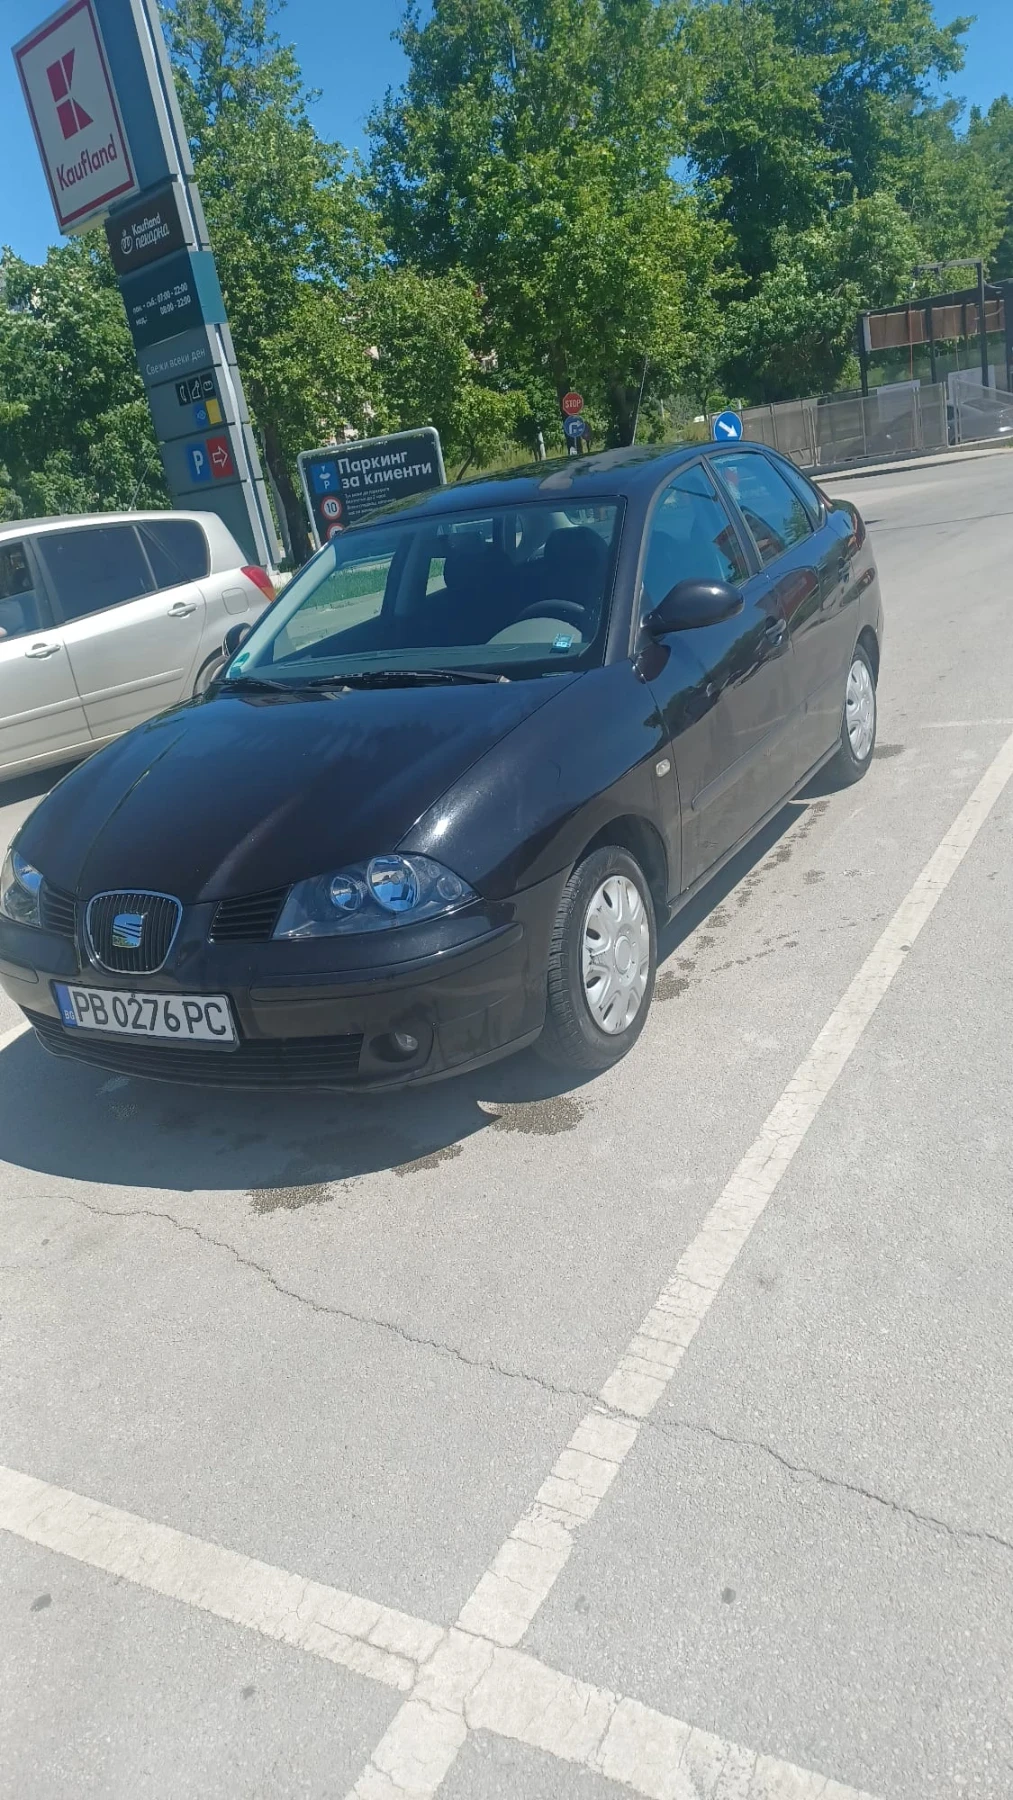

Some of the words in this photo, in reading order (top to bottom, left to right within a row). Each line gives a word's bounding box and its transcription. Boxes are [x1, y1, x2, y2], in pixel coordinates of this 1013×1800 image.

[56, 134, 118, 191] Kaufland
[131, 212, 161, 235] Kaufland
[157, 290, 171, 303] 07:00
[174, 282, 188, 296] 22:00
[160, 302, 174, 315] 08:00
[177, 295, 191, 307] 22:00
[146, 360, 168, 375] Свежи
[169, 354, 190, 368] всеки
[192, 348, 206, 361] ден
[565, 399, 581, 408] STOP
[337, 451, 408, 474] Паркинг
[341, 476, 359, 489] за
[364, 462, 432, 485] клиенти
[326, 502, 338, 514] 10
[64, 1010, 75, 1020] BG
